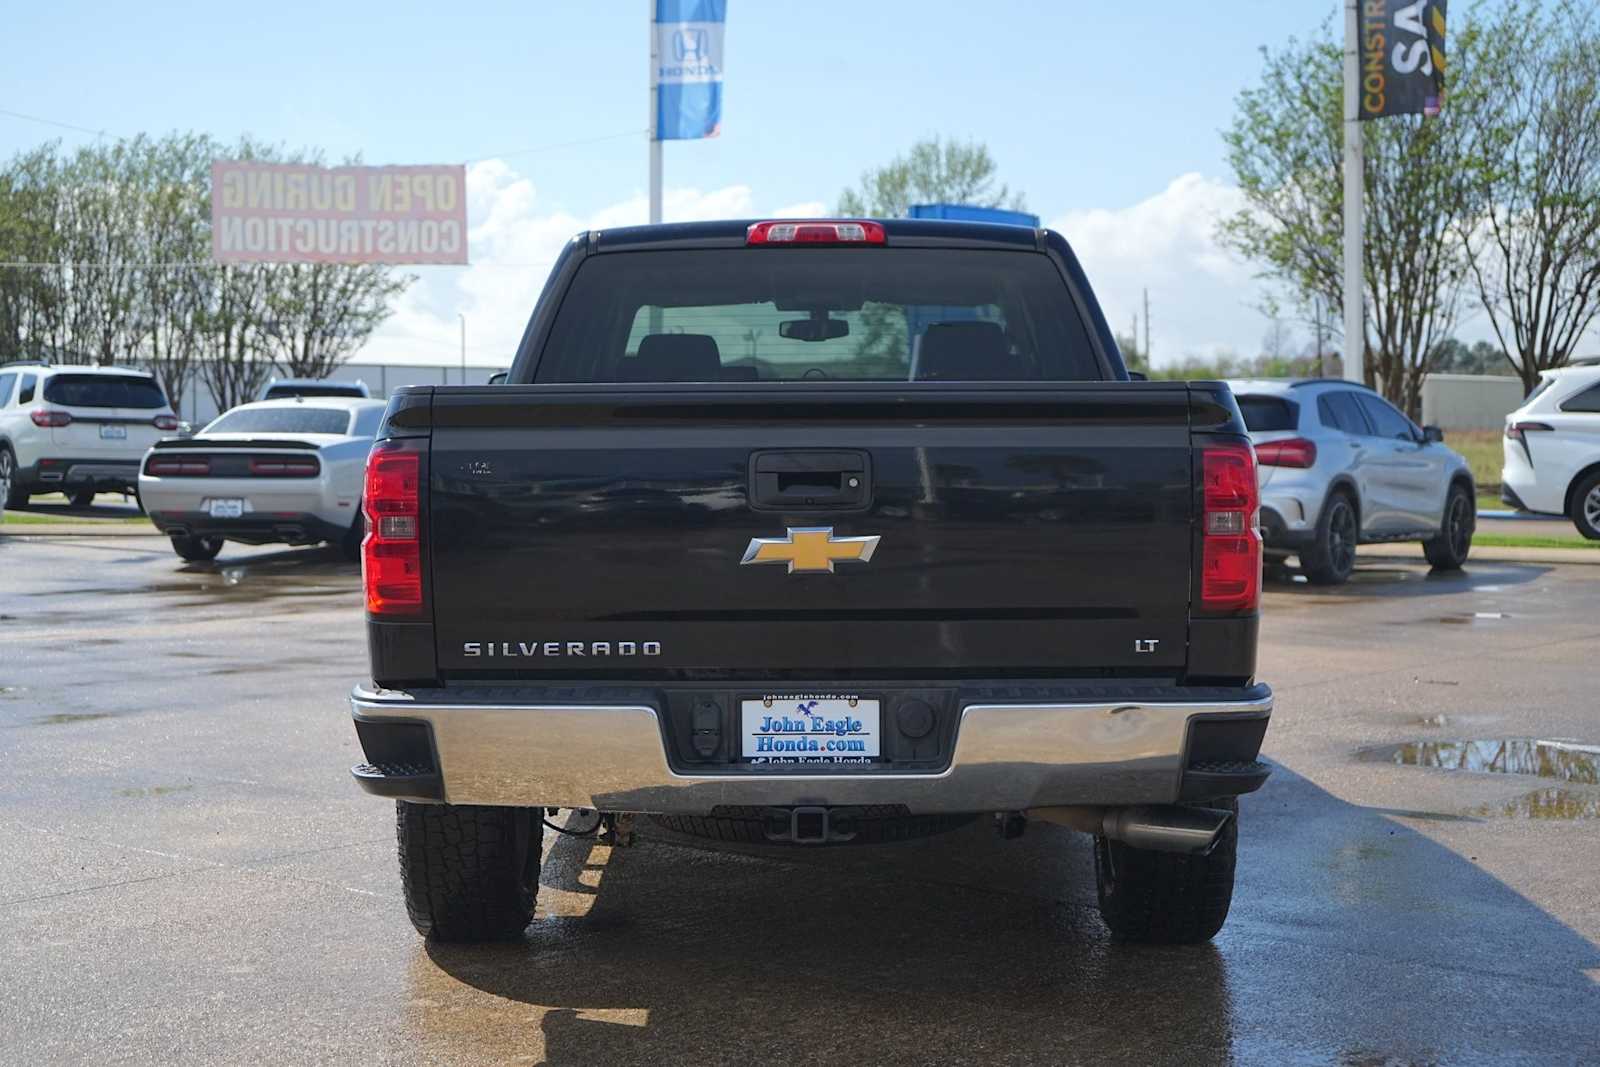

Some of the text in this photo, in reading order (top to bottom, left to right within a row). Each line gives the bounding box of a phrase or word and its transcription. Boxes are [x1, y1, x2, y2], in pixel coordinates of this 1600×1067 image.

[1391, 0, 1433, 76] SA
[1363, 0, 1386, 113] CONSTR
[463, 641, 662, 657] SILVERADO
[1135, 639, 1160, 653] LT
[759, 716, 863, 737] John Eagle
[756, 736, 866, 752] Honda.com
[768, 756, 795, 764] John
[833, 756, 872, 764] Honda
